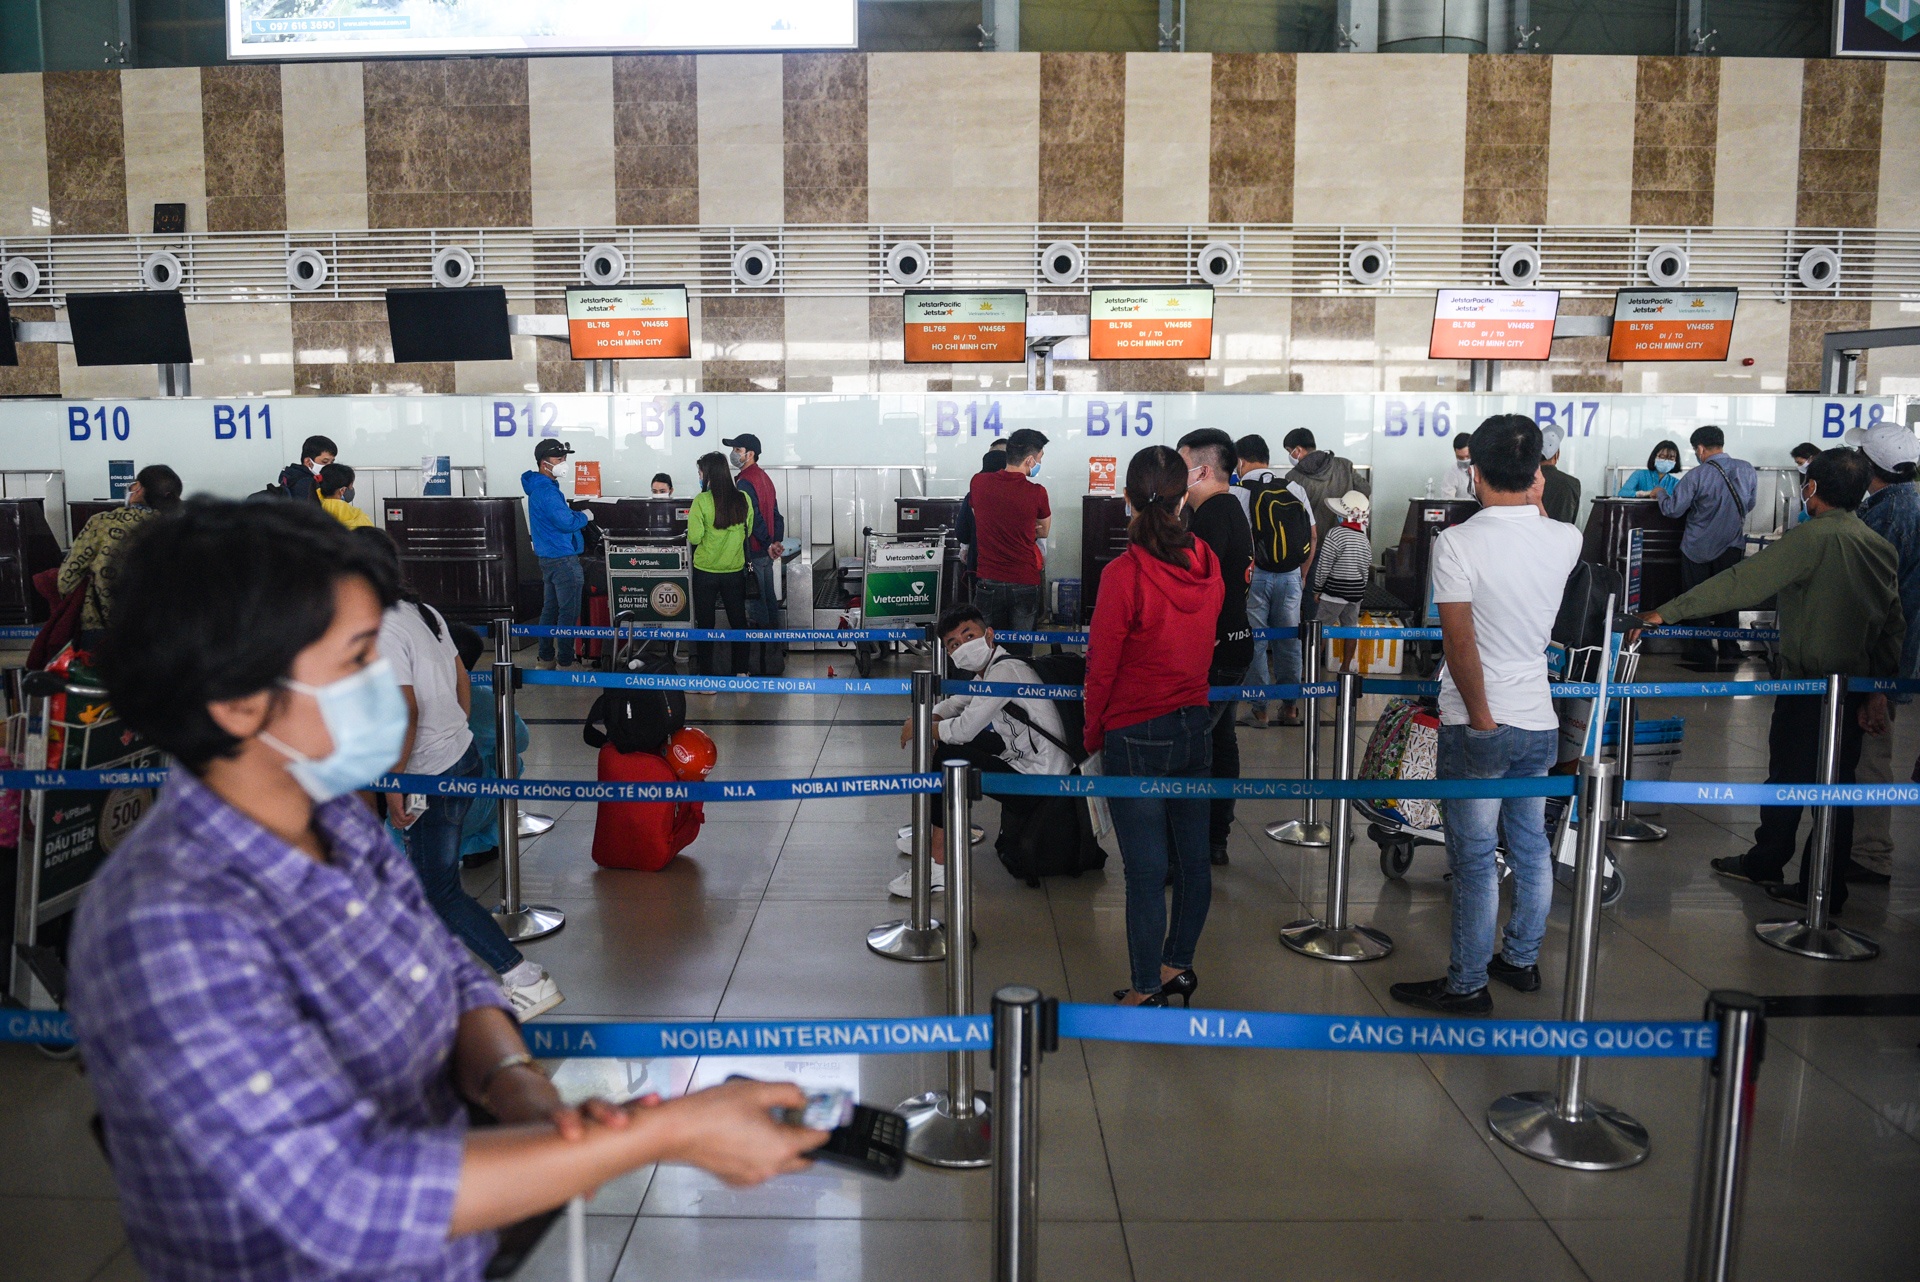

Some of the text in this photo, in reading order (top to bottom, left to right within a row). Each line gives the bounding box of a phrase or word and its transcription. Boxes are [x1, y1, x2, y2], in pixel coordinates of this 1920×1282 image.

[269, 22, 289, 31] 097
[310, 20, 336, 30] 3690
[587, 321, 610, 329] BL765
[641, 320, 669, 328] VN4565
[923, 325, 947, 333] BL765
[1164, 321, 1192, 329] VN4565
[1452, 321, 1476, 329] BL765
[1629, 323, 1654, 331] BL765
[1686, 323, 1715, 331] VN4565
[1166, 339, 1184, 347] CITY
[1458, 339, 1470, 347] HO
[1471, 339, 1485, 347] CHI
[1635, 342, 1648, 350] HO
[1649, 342, 1663, 350] CHI
[68, 405, 131, 441] B10
[213, 404, 272, 440] B11
[493, 401, 559, 438] B12
[640, 400, 706, 437] B13
[936, 400, 1004, 437] B14
[1086, 400, 1154, 437] B15
[1384, 400, 1451, 438] B16
[1534, 401, 1600, 438] B17
[1822, 402, 1885, 439] B18
[658, 593, 678, 604] 500
[873, 593, 930, 604] Vietcombank
[511, 627, 530, 635] N.I.A
[707, 631, 907, 639] N.I.A NOIBAI INTERNATIONAL AIRPORT N.I.A
[1067, 635, 1086, 643] N.I.A
[571, 674, 597, 684] N.I.A
[845, 682, 872, 691] N.I.A
[968, 684, 993, 694] N.I.A
[1754, 682, 1792, 692] NOIBAI
[1873, 681, 1897, 689] N.I.A
[1242, 685, 1336, 699] N.I.A NOIBAI
[35, 773, 67, 785] N.I.A
[99, 772, 145, 785] NOIBAI
[438, 778, 478, 794] CẢNG
[523, 783, 572, 798] KHÔNG
[618, 783, 635, 798] TẾ
[637, 783, 662, 800] NỘI
[723, 777, 942, 797] N.I.A NOIBAI INTERNATIONA
[1059, 779, 1096, 792] N.I.A
[1698, 787, 1735, 800] N.I.A
[1776, 786, 1819, 801] CẢNG
[1866, 786, 1919, 801] KHÔNG
[111, 798, 141, 831] 500
[534, 1029, 597, 1051] N.I.A
[660, 1027, 749, 1050] NOIBAI
[754, 1023, 963, 1049] INTERNATIONAL
[1188, 1016, 1254, 1041] N.I.A
[1327, 1019, 1405, 1047] CẢNG
[1410, 1021, 1487, 1048] HÀNG
[1491, 1021, 1588, 1050] KHÔNG
